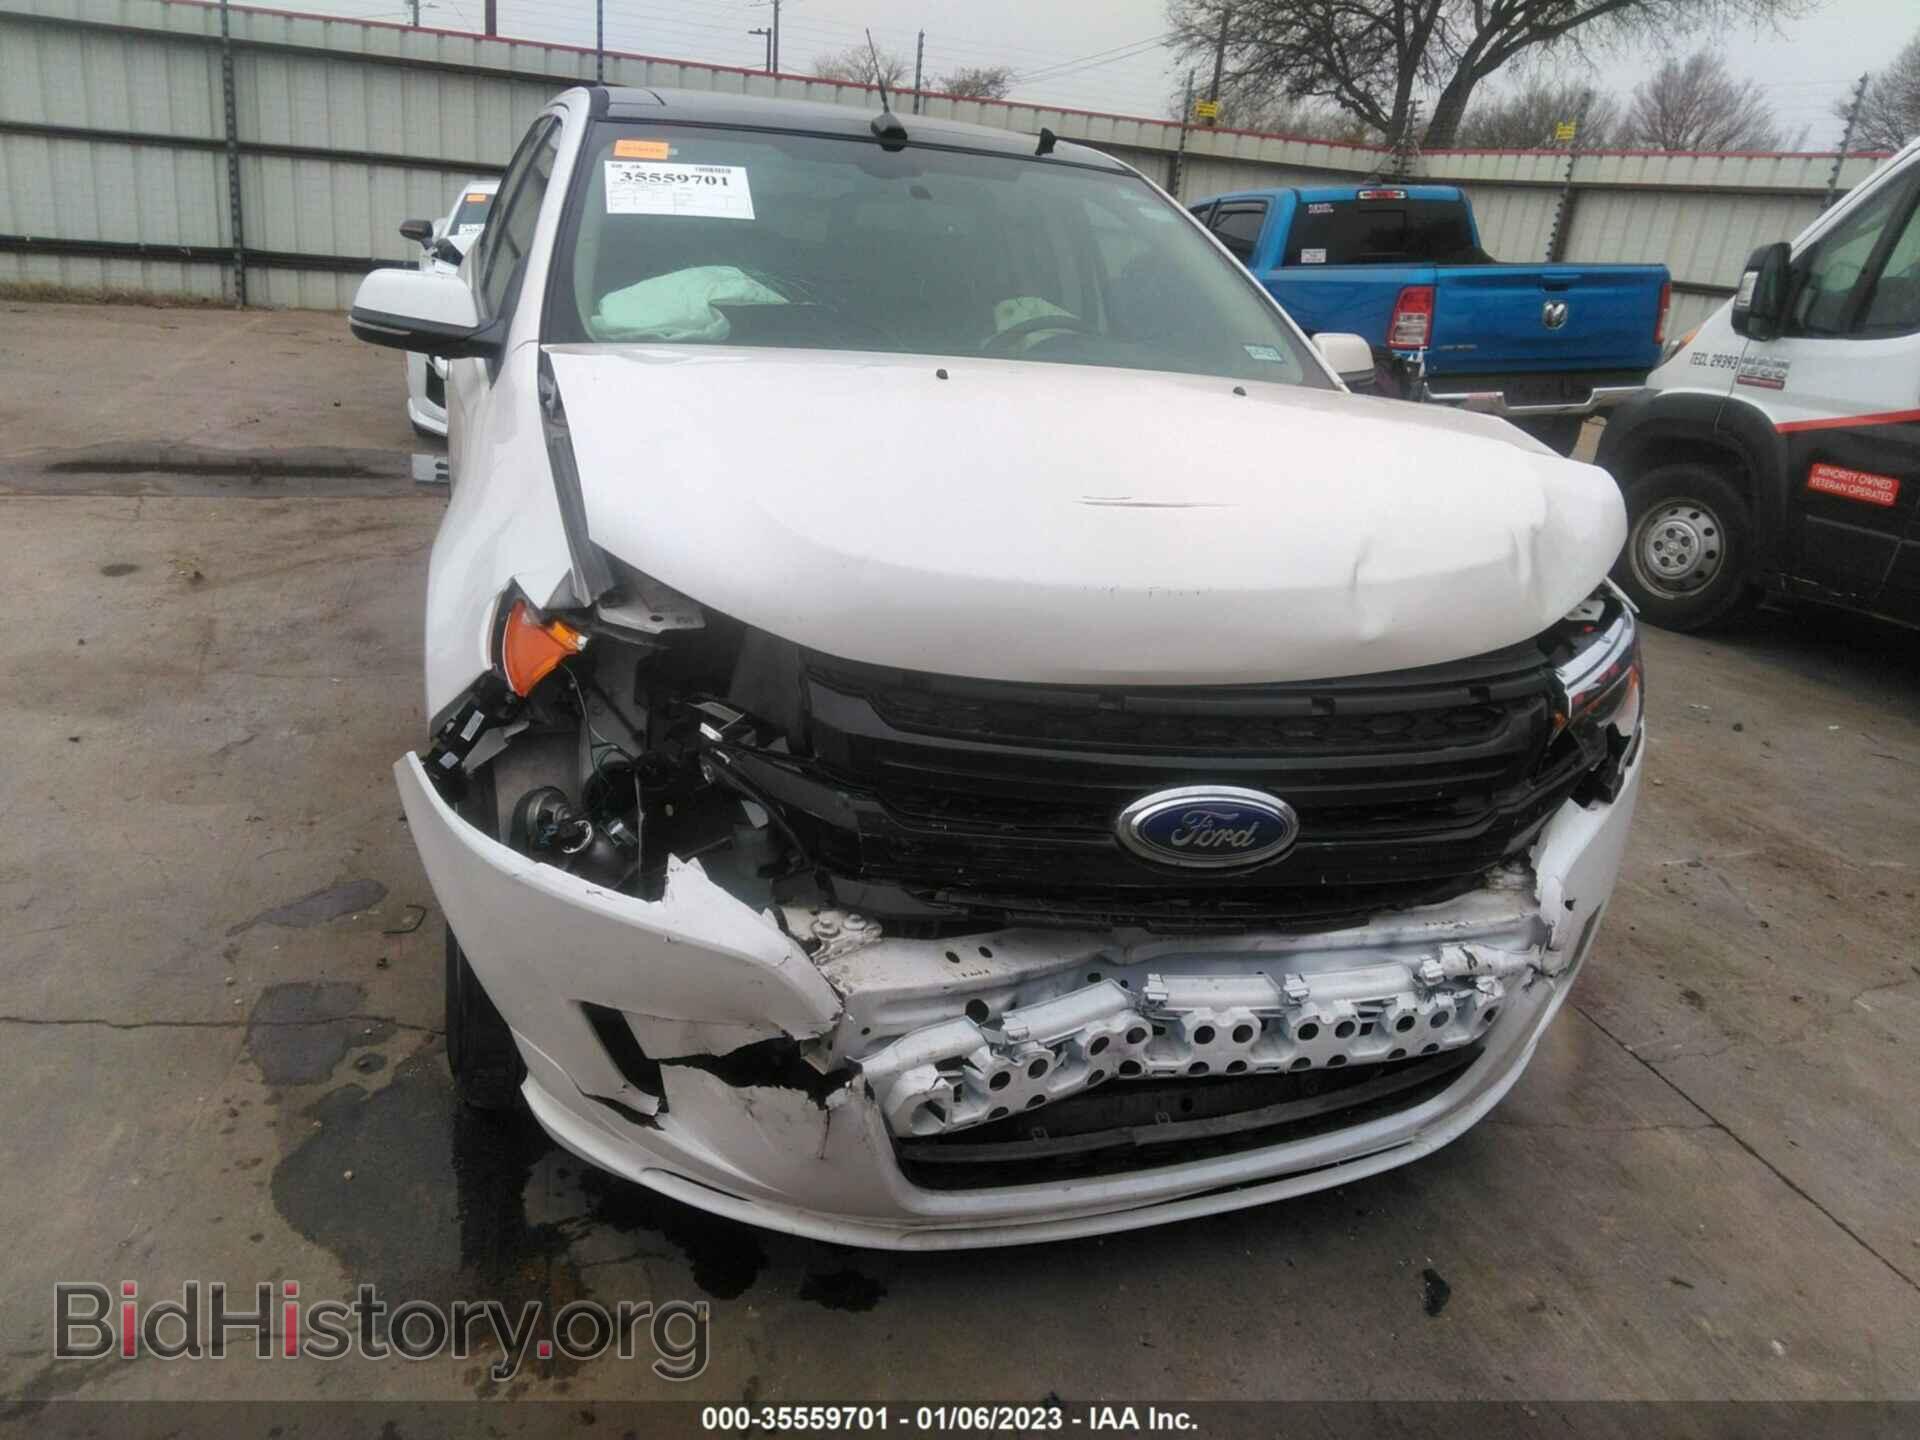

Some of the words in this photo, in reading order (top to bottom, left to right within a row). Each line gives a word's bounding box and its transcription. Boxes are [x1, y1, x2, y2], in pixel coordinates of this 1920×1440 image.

[620, 171, 729, 186] 35559701
[1811, 477, 1847, 492] VETERAN
[1848, 484, 1894, 502] OPERATED
[1818, 466, 1857, 482] MINORITY
[1858, 474, 1892, 490] OWNED
[1171, 810, 1260, 847] Ford
